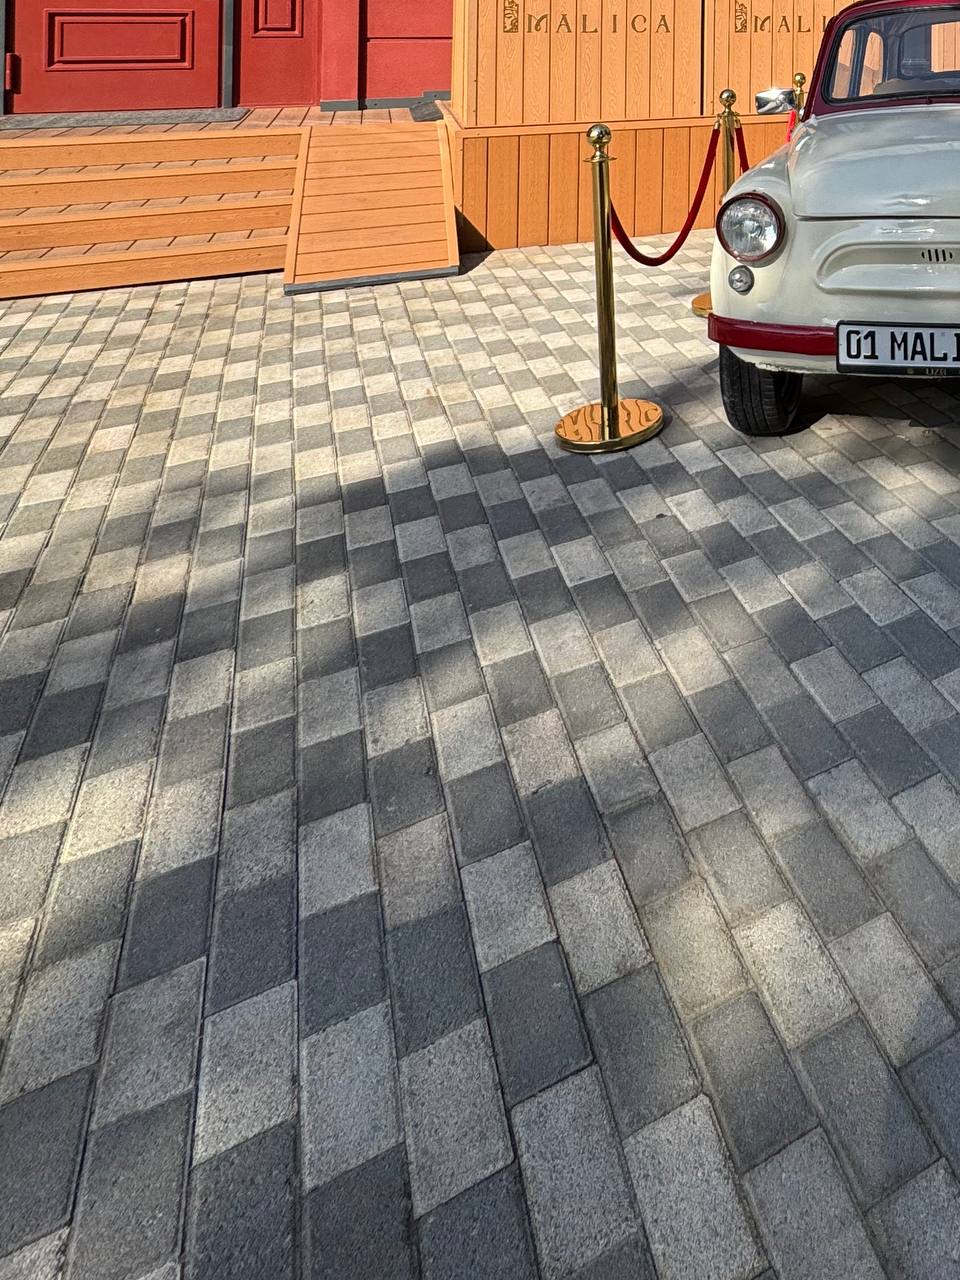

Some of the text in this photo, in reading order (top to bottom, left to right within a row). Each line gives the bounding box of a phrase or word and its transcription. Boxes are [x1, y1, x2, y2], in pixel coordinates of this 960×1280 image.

[526, 13, 671, 34] MALICA
[753, 15, 828, 33] MALI
[846, 329, 879, 360] 01
